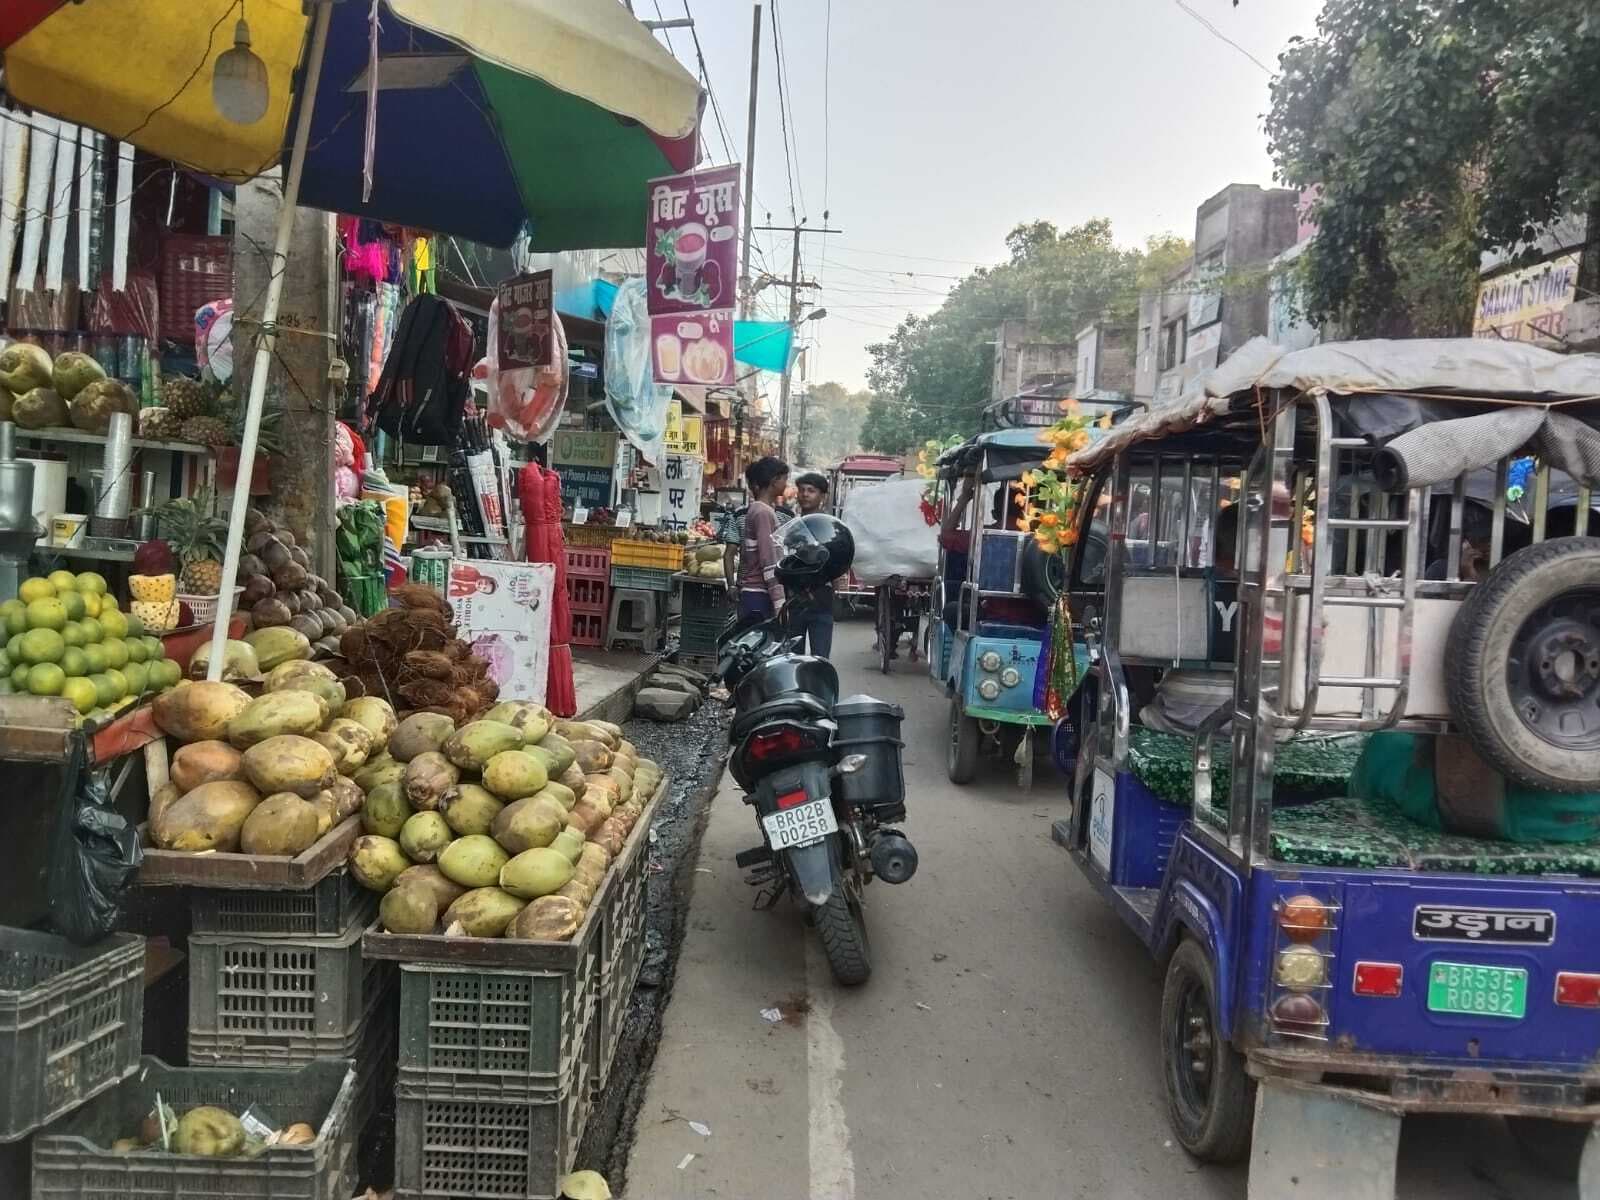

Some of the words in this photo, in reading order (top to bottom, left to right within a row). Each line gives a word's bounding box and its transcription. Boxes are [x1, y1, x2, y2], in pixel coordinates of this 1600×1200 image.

[652, 185, 689, 222] बिट
[695, 181, 735, 225] जूस
[669, 488, 685, 509] पर
[776, 802, 824, 829] BR02B
[780, 818, 828, 845] D0258
[1419, 910, 1550, 938] उड़ान
[1448, 966, 1515, 993] BR53E
[1447, 988, 1514, 1013] R0892
